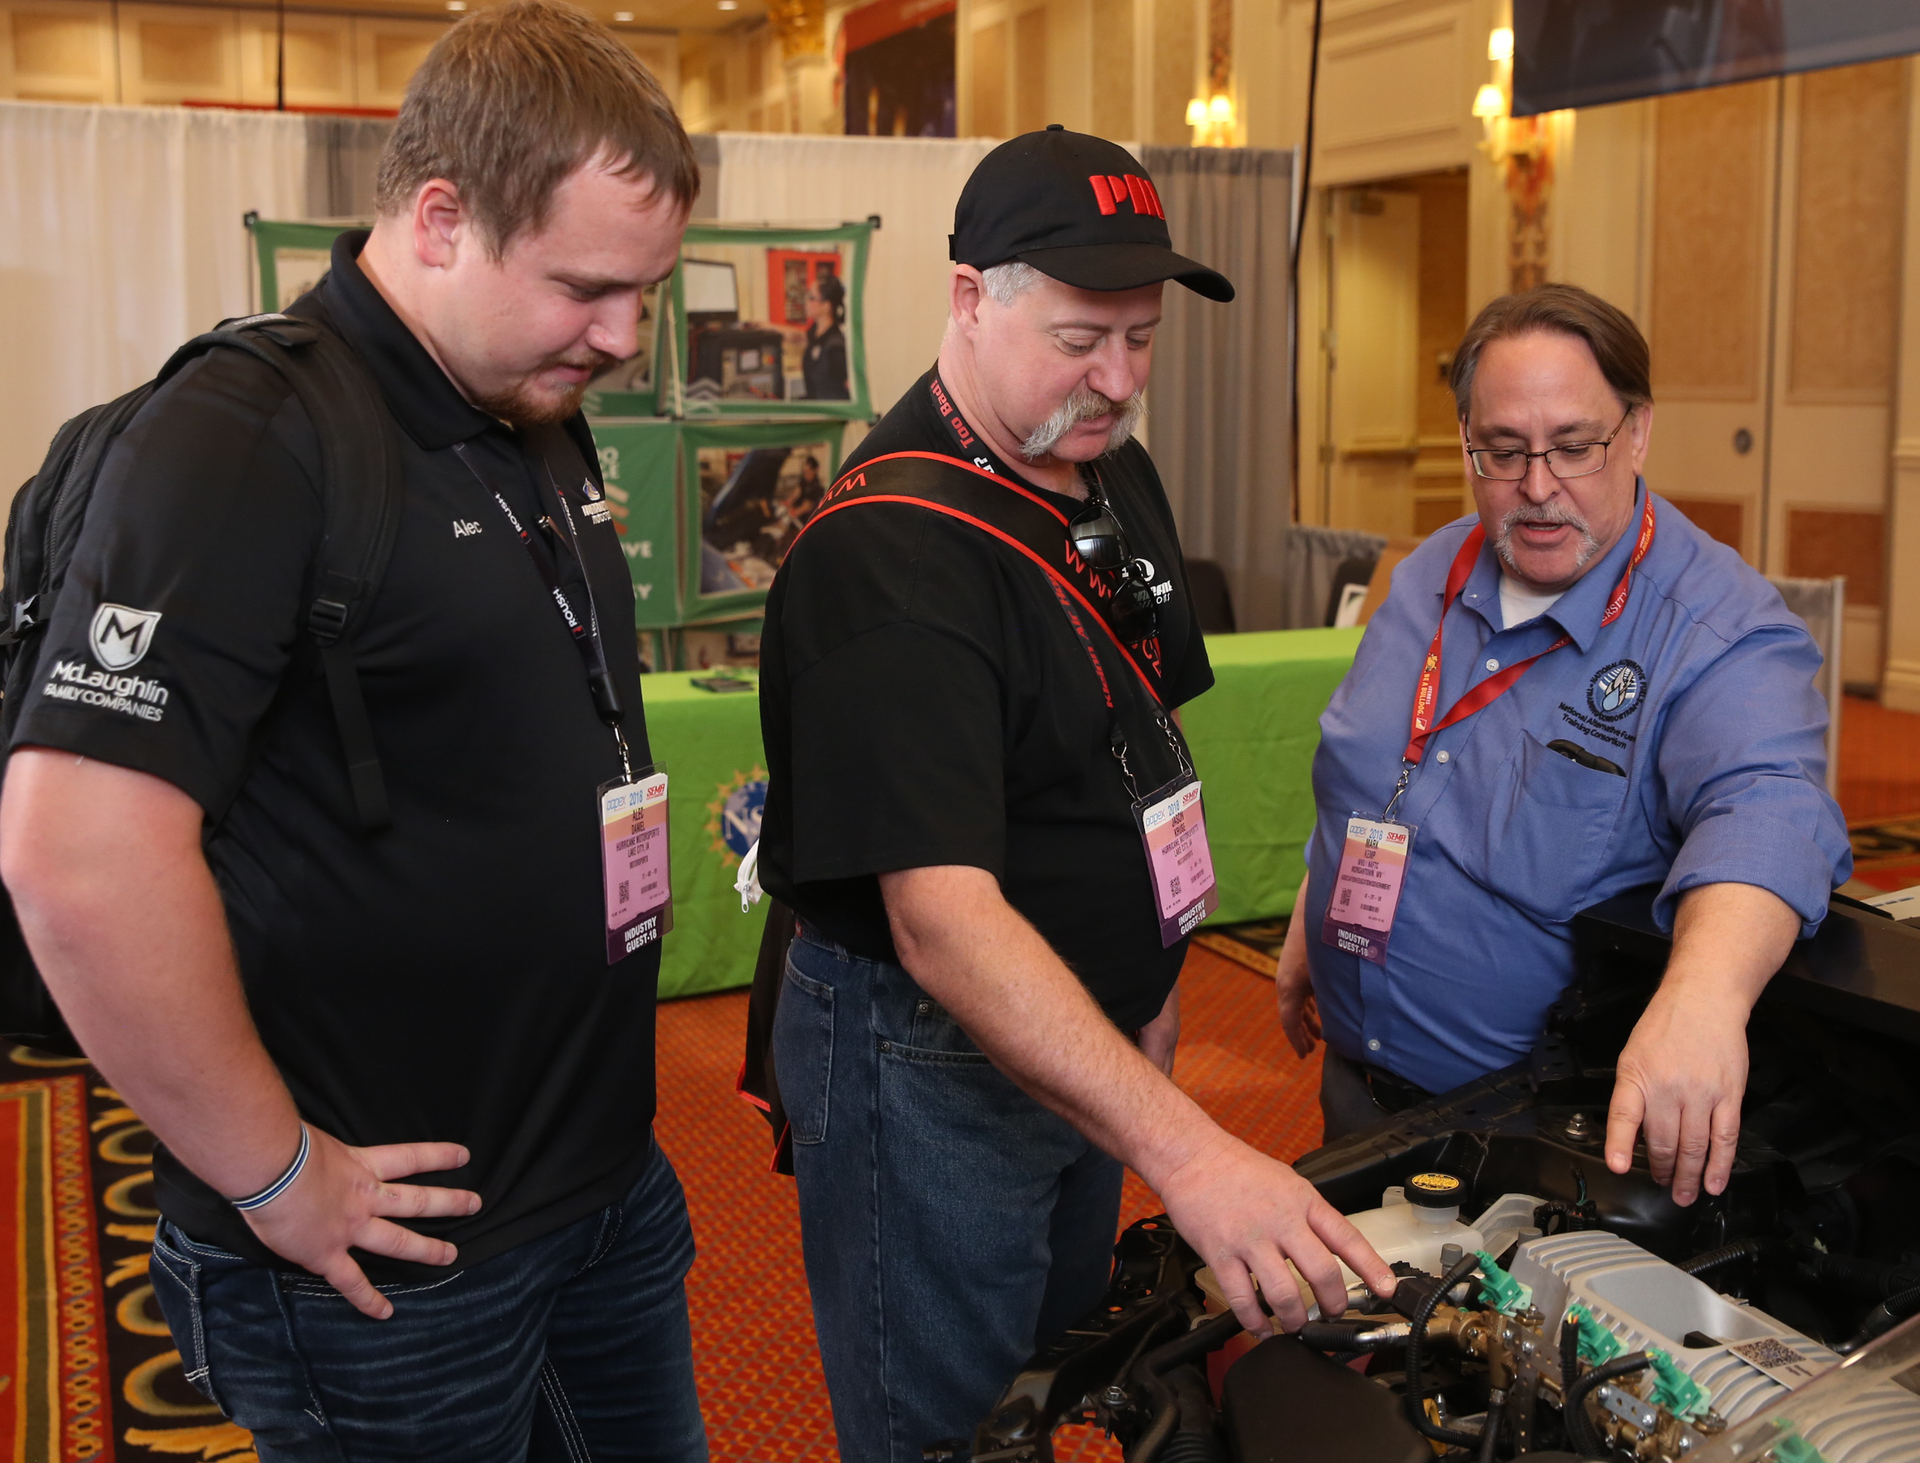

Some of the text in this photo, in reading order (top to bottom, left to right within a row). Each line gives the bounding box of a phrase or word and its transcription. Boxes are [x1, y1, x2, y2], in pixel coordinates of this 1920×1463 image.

[930, 379, 974, 449] Too Bad!
[495, 491, 522, 532] ROUSH
[452, 519, 483, 538] Alec
[552, 588, 577, 628] ROUSH
[99, 611, 150, 655] M
[50, 661, 169, 705] McLaughlin
[43, 683, 163, 722] FAMILY COMPANIES
[1558, 701, 1588, 721] National
[1587, 716, 1621, 737] Alternative
[1562, 713, 1627, 749] Training Consortium
[630, 791, 643, 806] 2018
[647, 784, 665, 797] SEMA
[1168, 800, 1180, 816] 2018
[633, 808, 644, 821] ALEC
[632, 822, 645, 835] DANIEL
[1370, 829, 1384, 840] 2018
[1387, 832, 1406, 842] SEMA
[1366, 839, 1379, 849] MARK
[1179, 899, 1205, 927] INDUSTRY
[625, 916, 657, 942] INDUSTRY
[627, 929, 657, 953] GUEST-18
[1338, 929, 1370, 947] INDUSTRY
